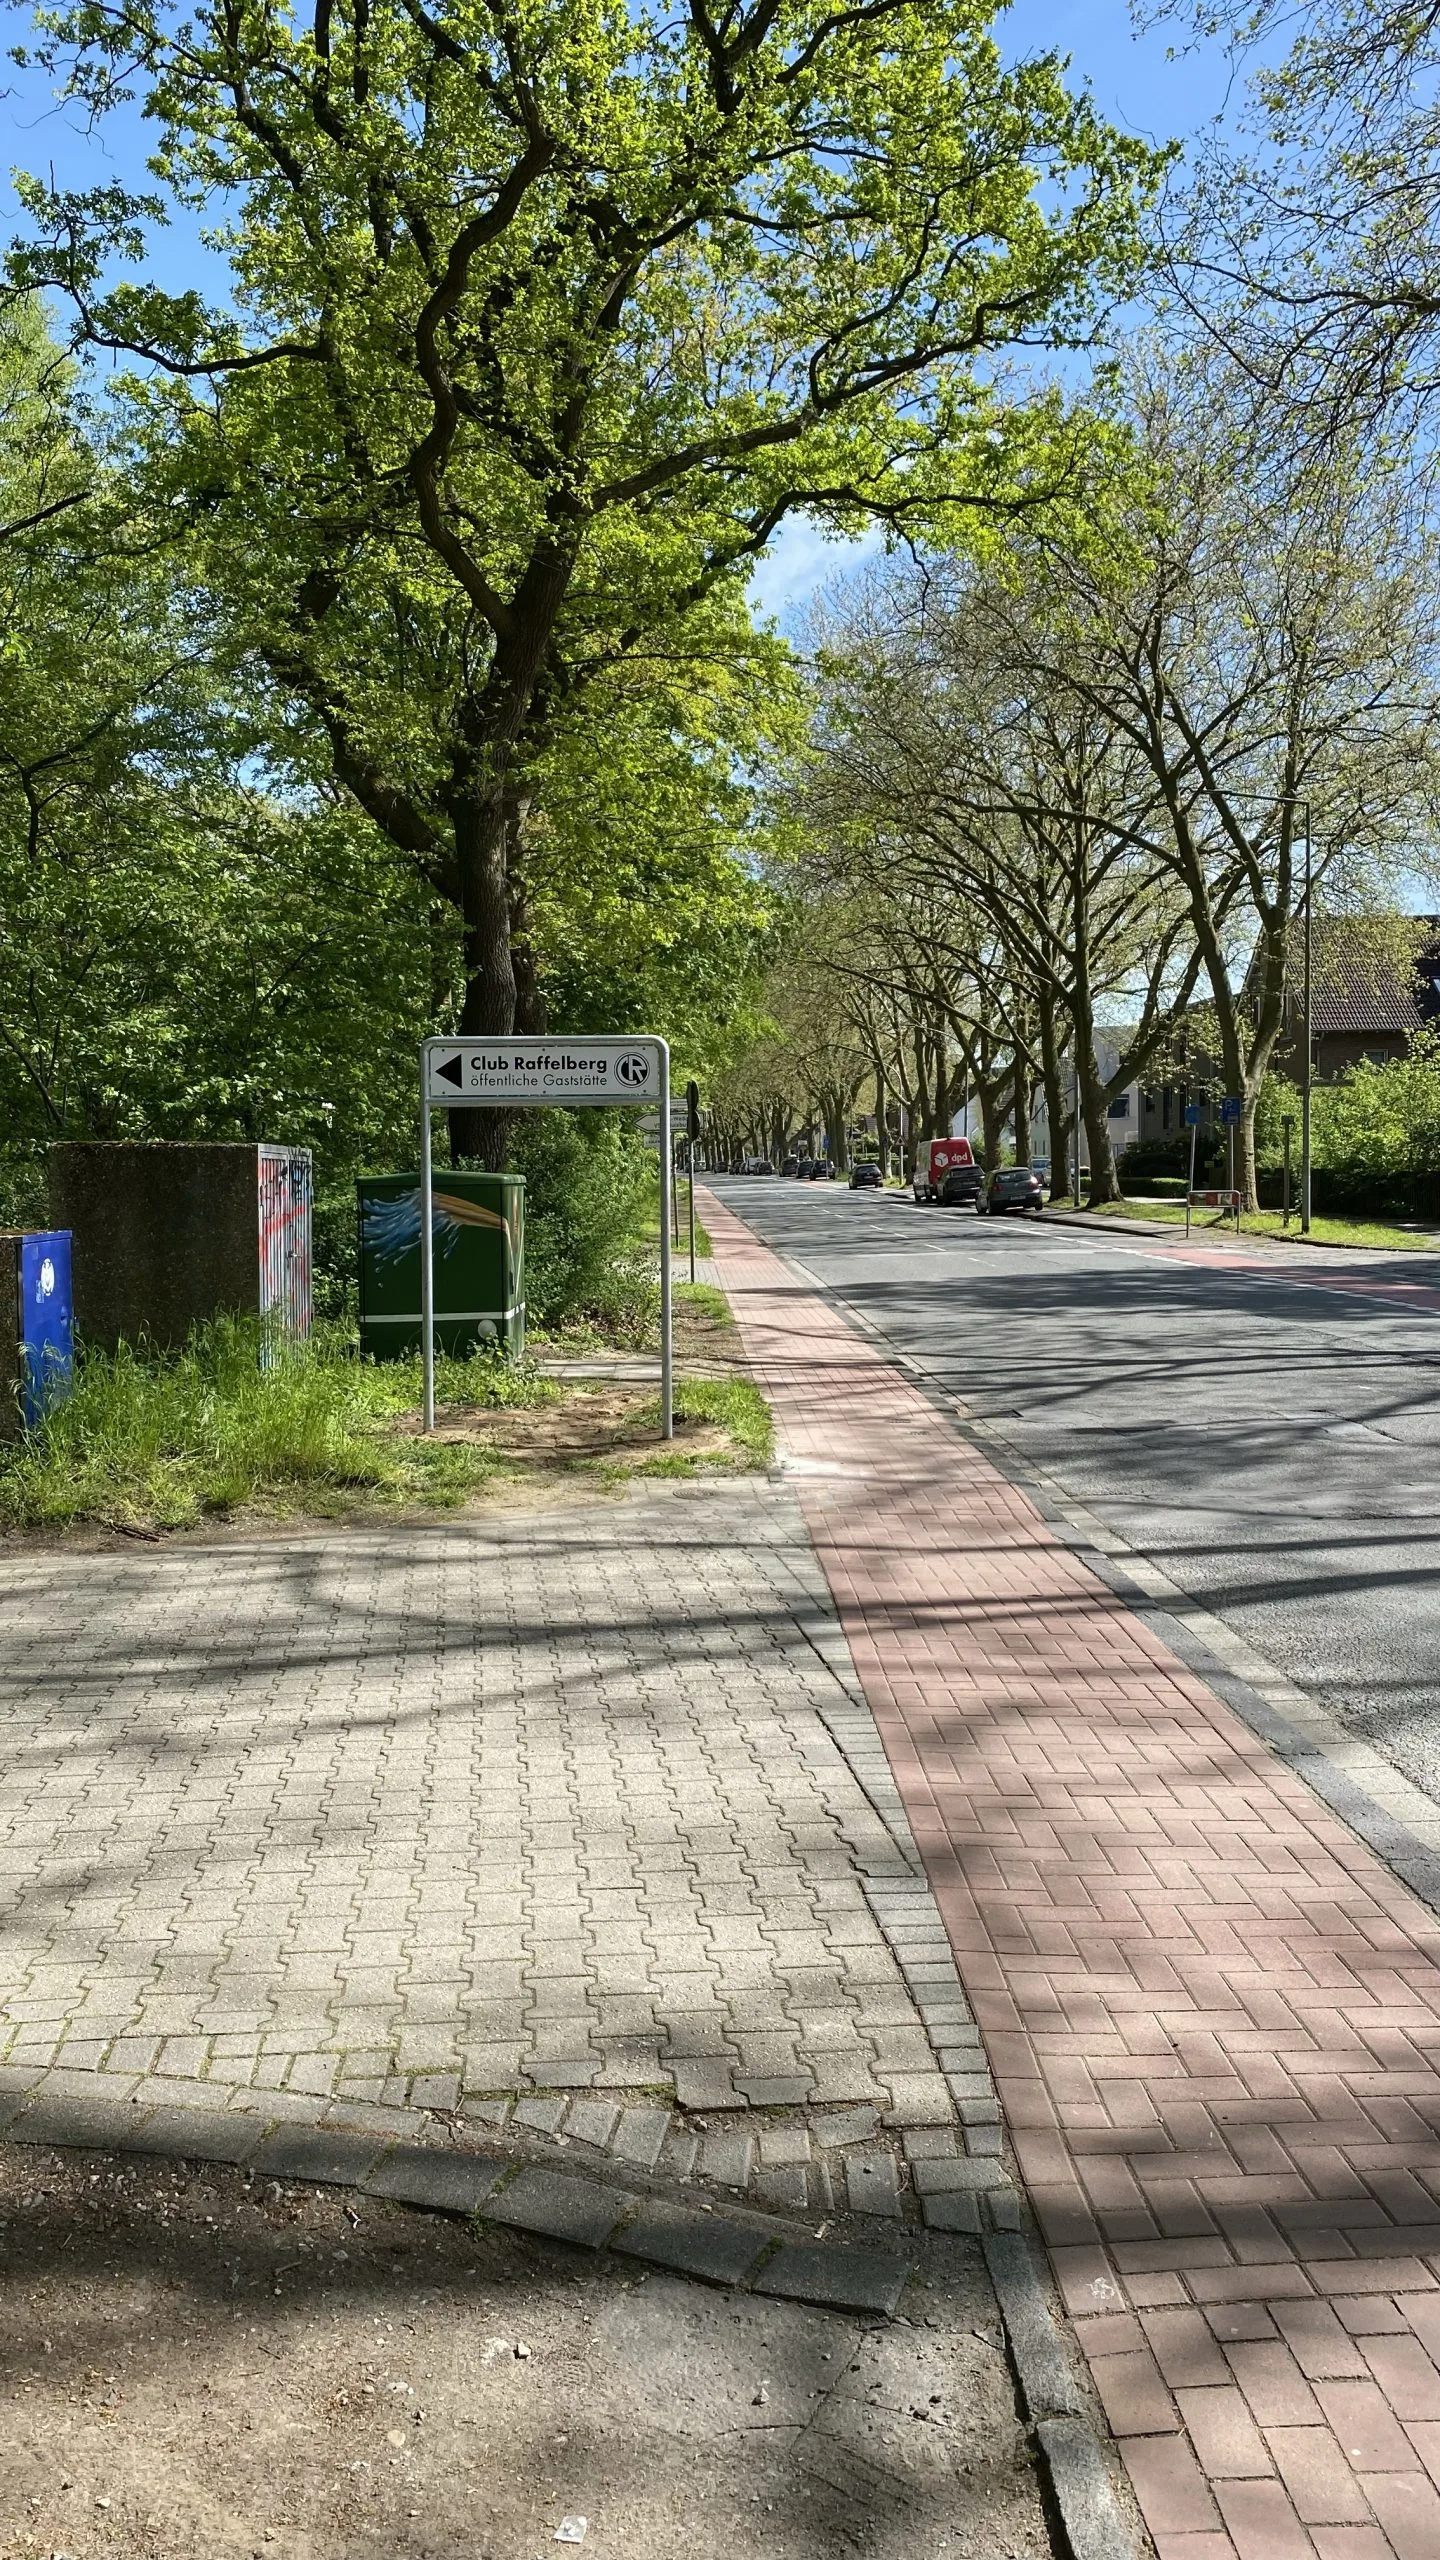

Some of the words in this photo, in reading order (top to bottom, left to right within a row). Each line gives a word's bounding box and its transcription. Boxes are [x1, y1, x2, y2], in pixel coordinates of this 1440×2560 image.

[470, 1055, 509, 1071] Club
[514, 1055, 607, 1074] Raffelberg
[470, 1073, 538, 1087] öffentliche
[543, 1073, 608, 1087] Gaststätte
[951, 1153, 968, 1163] dpd
